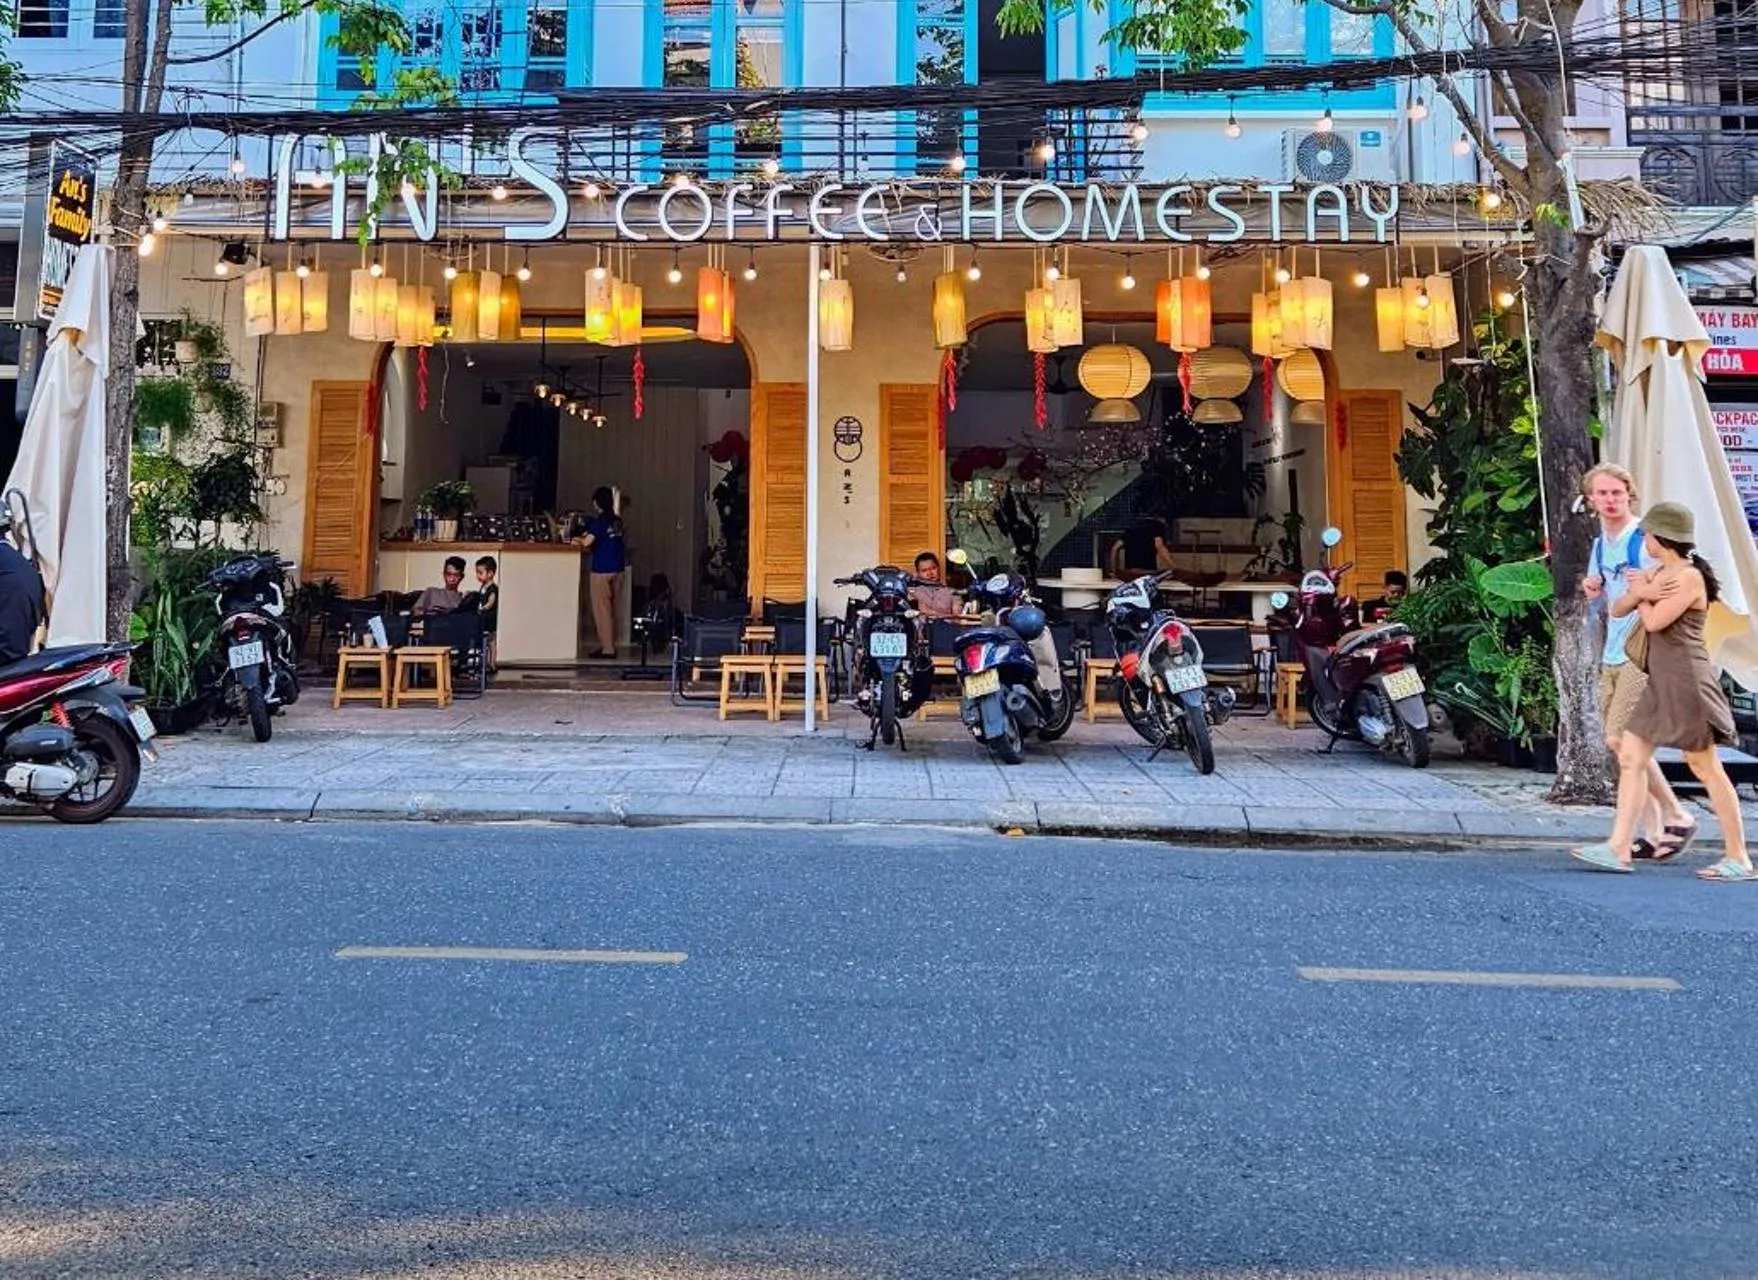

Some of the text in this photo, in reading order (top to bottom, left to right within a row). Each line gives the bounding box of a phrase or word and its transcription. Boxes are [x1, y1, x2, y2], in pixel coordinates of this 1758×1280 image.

[59, 169, 88, 203] An's
[50, 195, 92, 241] Family
[615, 183, 890, 242] COFFEE
[915, 204, 943, 242] &
[962, 183, 1399, 242] HOMESTAY
